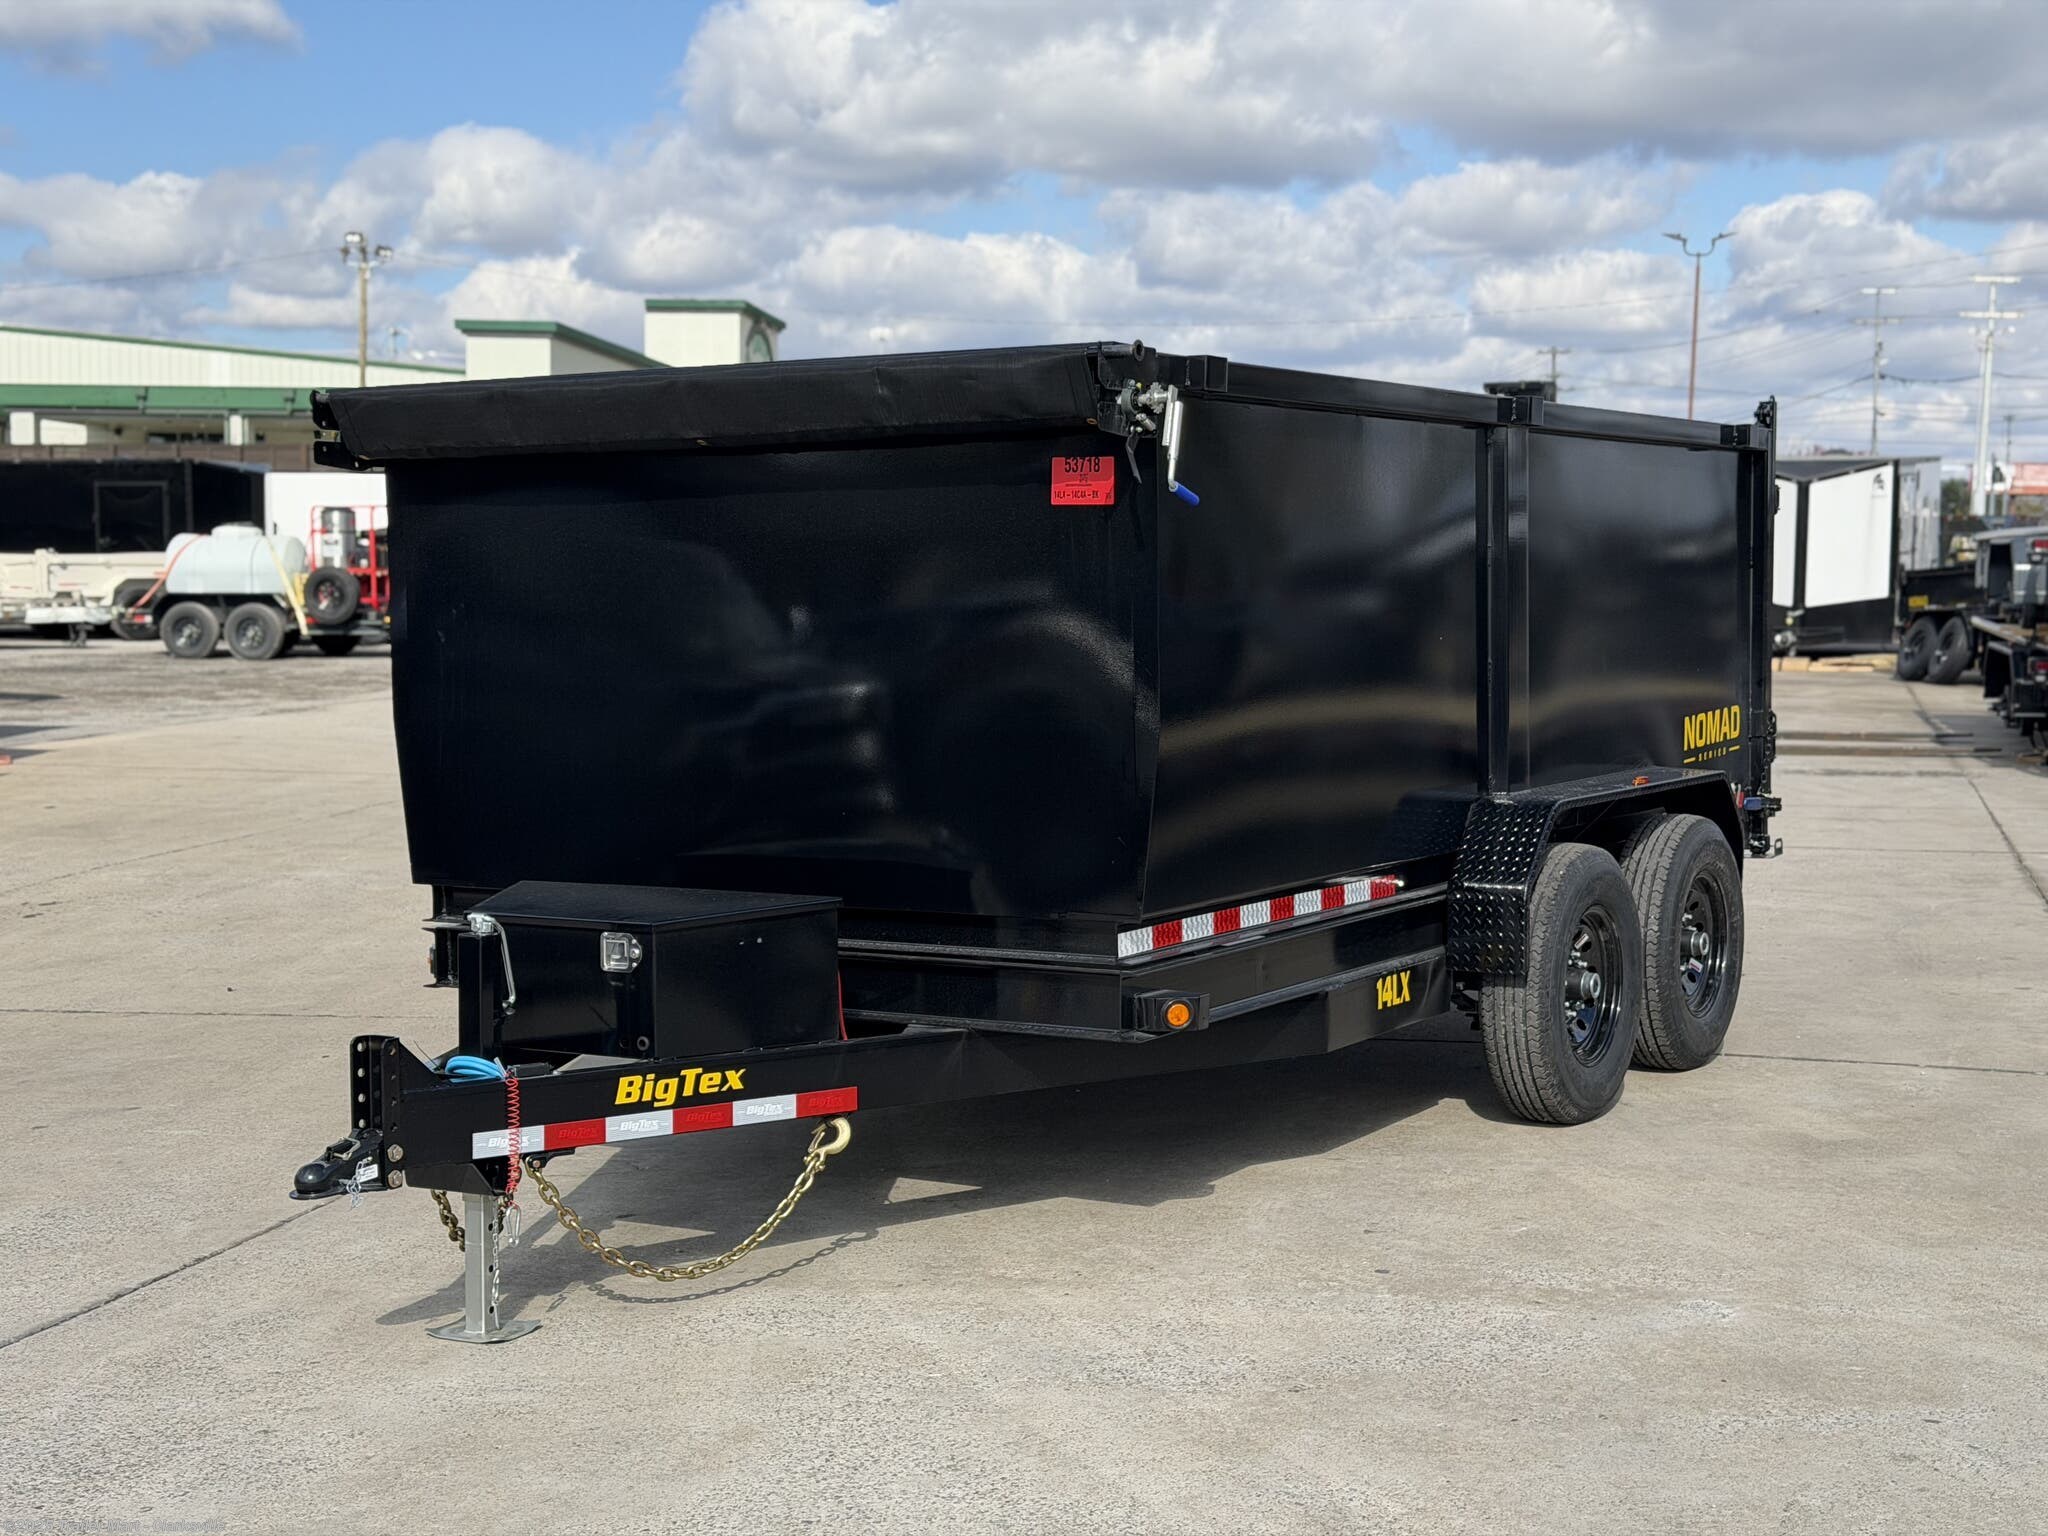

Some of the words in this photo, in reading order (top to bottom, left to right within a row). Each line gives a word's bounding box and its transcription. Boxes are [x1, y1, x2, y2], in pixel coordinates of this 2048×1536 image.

[1064, 456, 1100, 473] 53718
[1684, 705, 1740, 752] NOMAD
[1376, 970, 1410, 1010] 14LX
[614, 1067, 746, 1108] BigTex
